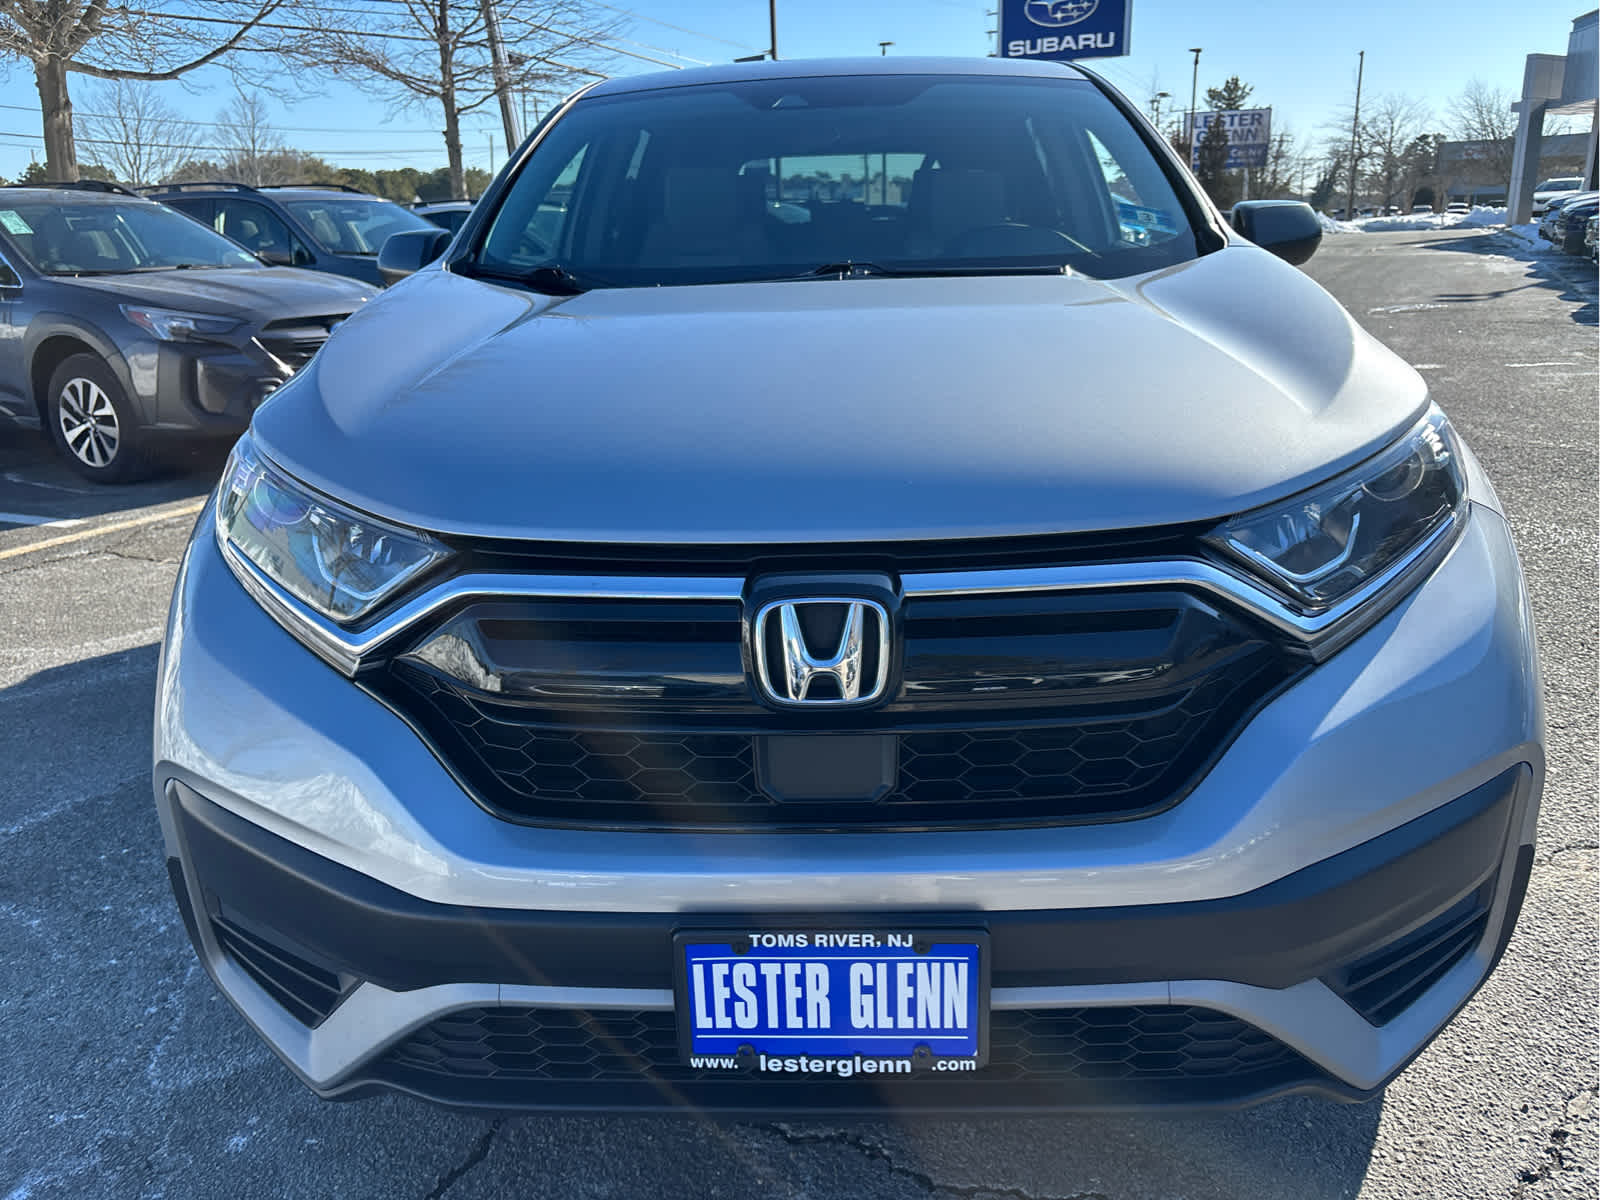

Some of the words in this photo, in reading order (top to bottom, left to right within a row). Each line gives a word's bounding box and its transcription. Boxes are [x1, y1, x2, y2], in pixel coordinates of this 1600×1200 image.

[1008, 32, 1115, 56] SUBARU
[1196, 128, 1258, 144] GNN
[749, 934, 808, 947] TOMS
[815, 934, 881, 948] RIVER,
[887, 934, 913, 947] NJ
[692, 962, 831, 1029] LESTER
[849, 962, 969, 1029] GLENN
[690, 1057, 739, 1069] www.
[759, 1054, 912, 1077] lesterglenn
[931, 1057, 976, 1071] .com
